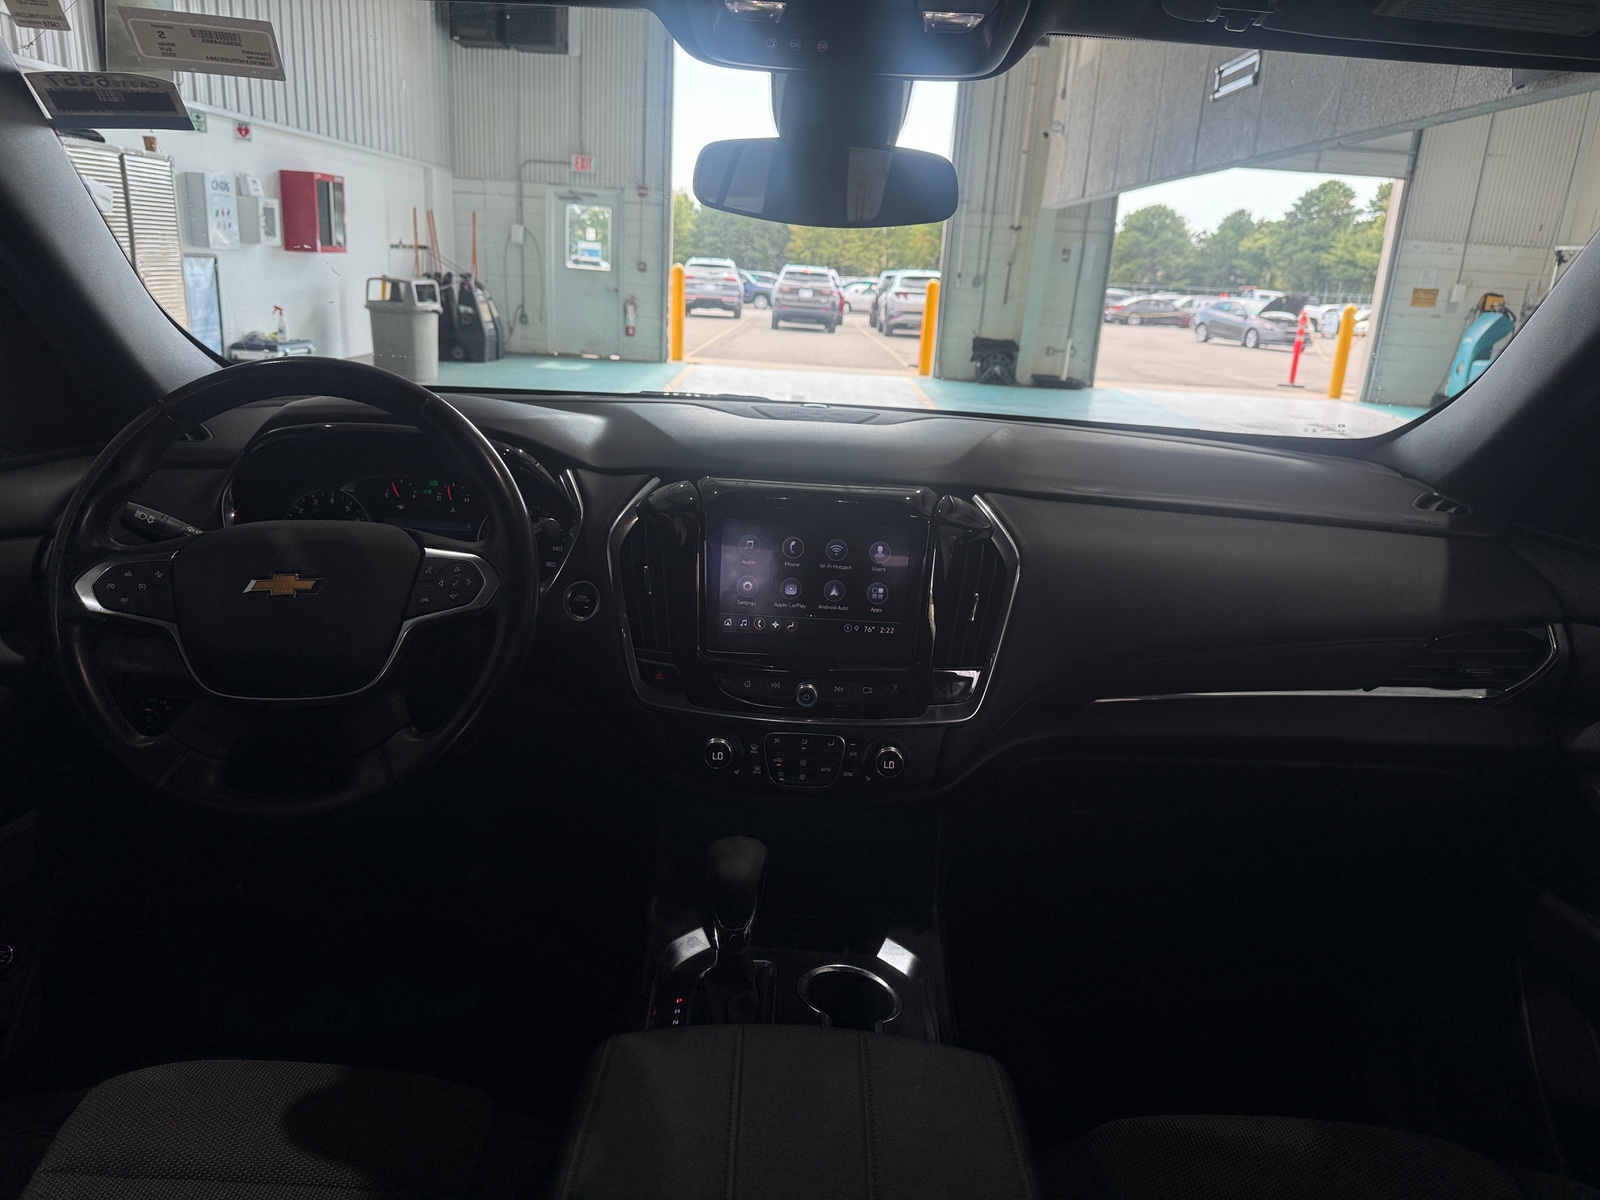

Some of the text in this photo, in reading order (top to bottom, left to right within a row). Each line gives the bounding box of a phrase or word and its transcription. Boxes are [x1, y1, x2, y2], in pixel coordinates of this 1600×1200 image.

[574, 154, 592, 170] EXIT
[880, 626, 894, 634] 2:22
[712, 752, 723, 760] LO
[883, 761, 894, 769] LO
